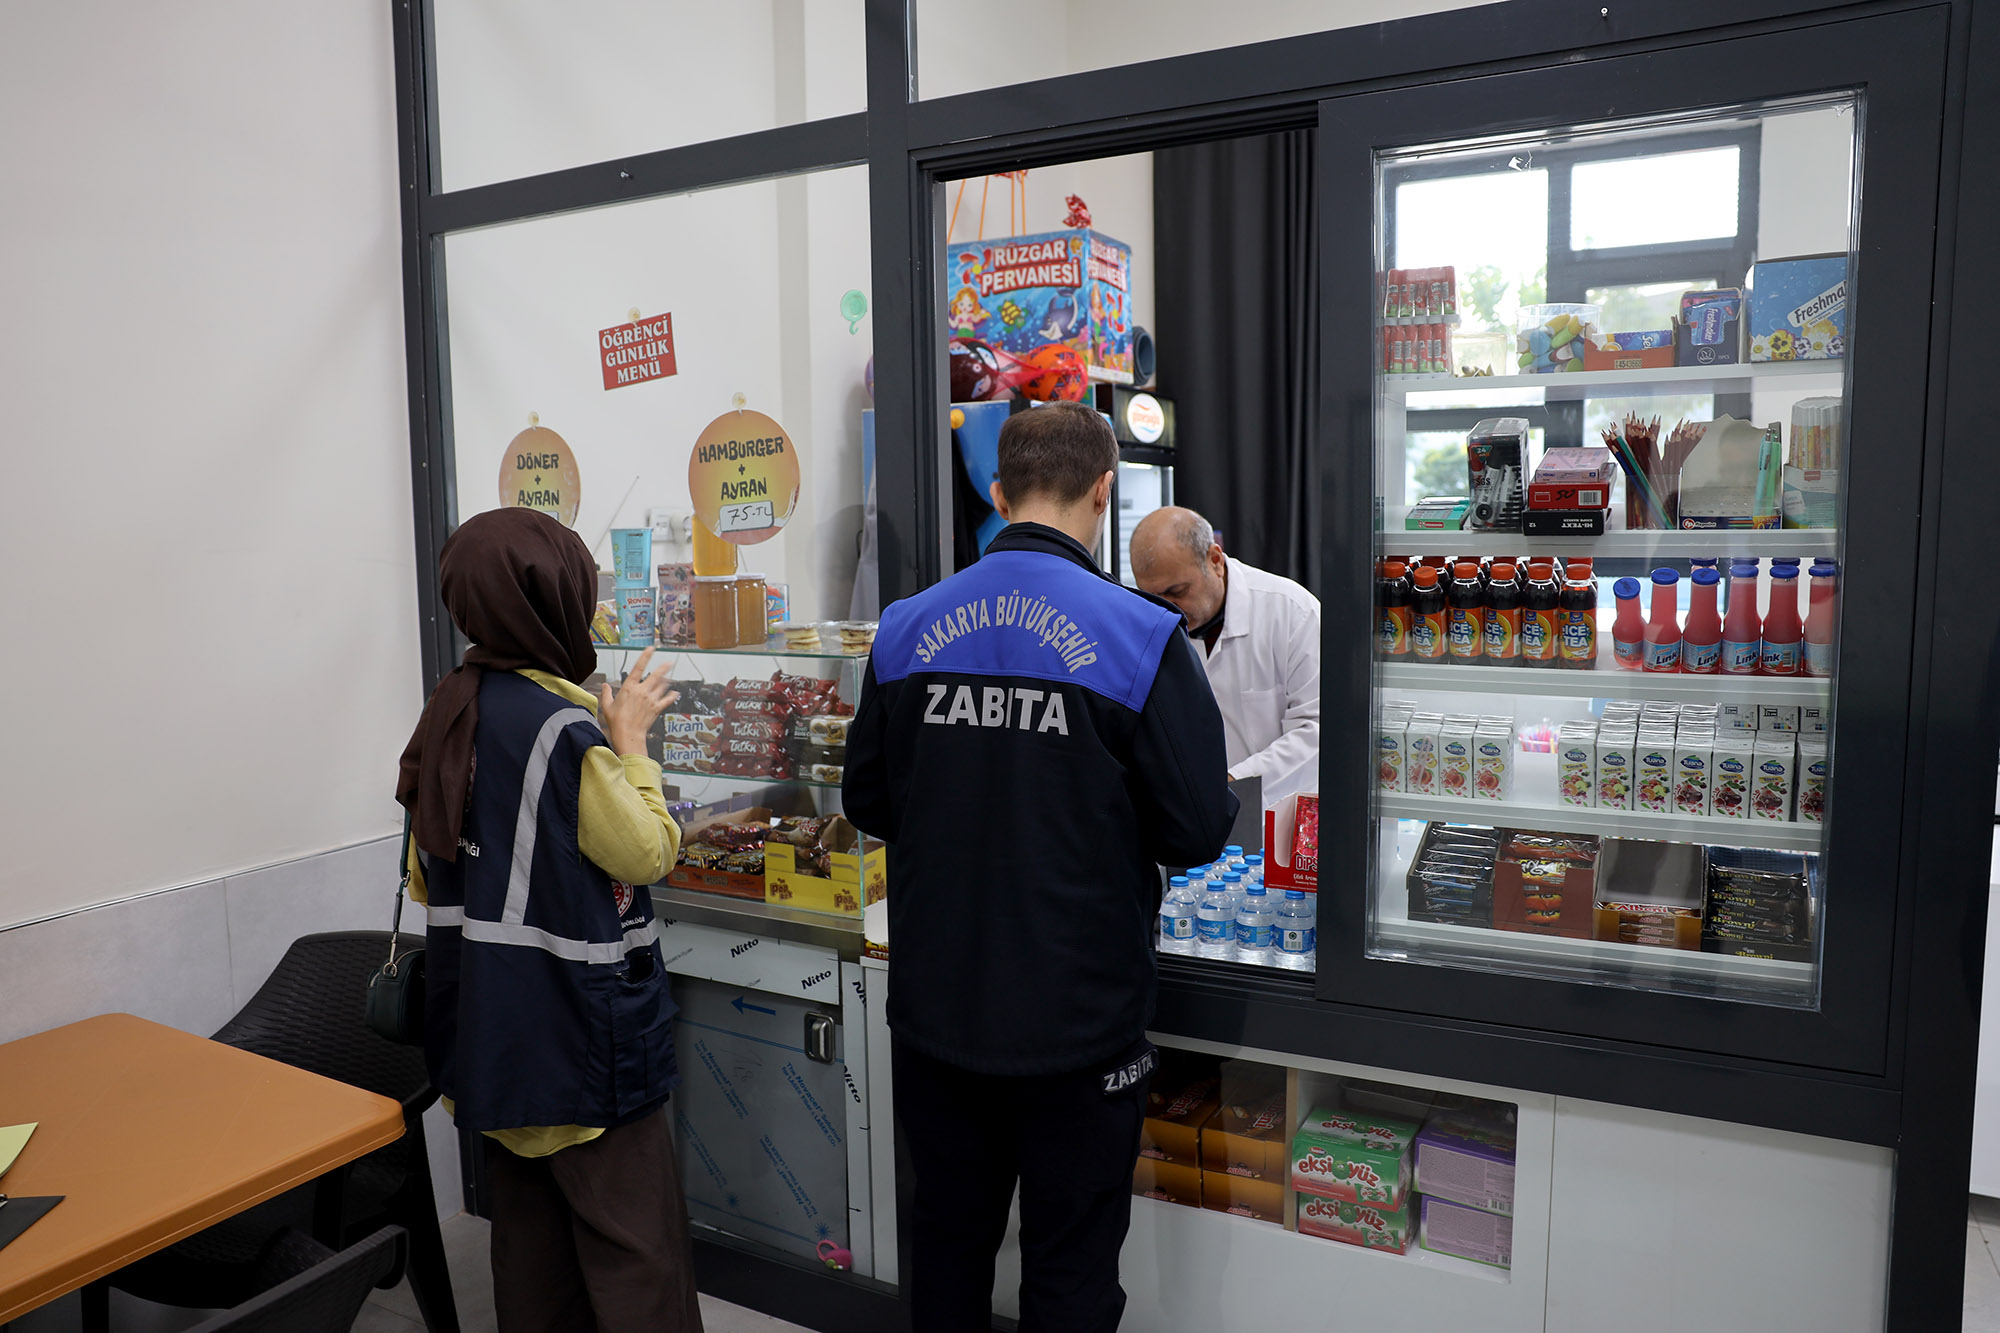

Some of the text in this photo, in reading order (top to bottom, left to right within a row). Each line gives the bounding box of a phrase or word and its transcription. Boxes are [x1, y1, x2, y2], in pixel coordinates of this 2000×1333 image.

[994, 238, 1067, 268] RÜZGAR
[982, 257, 1080, 294] PERVANESİ
[1794, 280, 1847, 323] Freshma
[602, 315, 669, 350] ÖĞRENCİ
[605, 338, 669, 366] GÜNLÜK
[617, 360, 661, 384] MENÜ
[699, 436, 785, 463] HAMBURGER
[516, 452, 559, 471] DÖNER
[517, 490, 560, 507] AYRAN
[720, 477, 768, 500] AYRAN
[916, 589, 1097, 674] SAKARYA BÜYÜKŞEHİR
[1564, 636, 1588, 647] TEA
[1566, 624, 1586, 636] ICE
[1656, 651, 1677, 665] Link
[1697, 652, 1719, 666] Link
[1735, 651, 1757, 665] Link
[923, 684, 1069, 736] ZABITA
[667, 722, 704, 733] ikram
[731, 721, 760, 737] Tutku
[666, 750, 702, 761] ikram
[729, 740, 757, 752] Tutku
[1617, 905, 1668, 913] Albeni
[730, 936, 759, 959] Nitto
[801, 969, 832, 990] Nitto
[1104, 1054, 1153, 1090] ZABITA
[786, 1076, 803, 1096] LASER
[813, 1115, 829, 1135] LASER
[1298, 1155, 1332, 1175] ekşi
[1348, 1161, 1379, 1187] yüz
[1306, 1200, 1386, 1231] ekşi yüz
